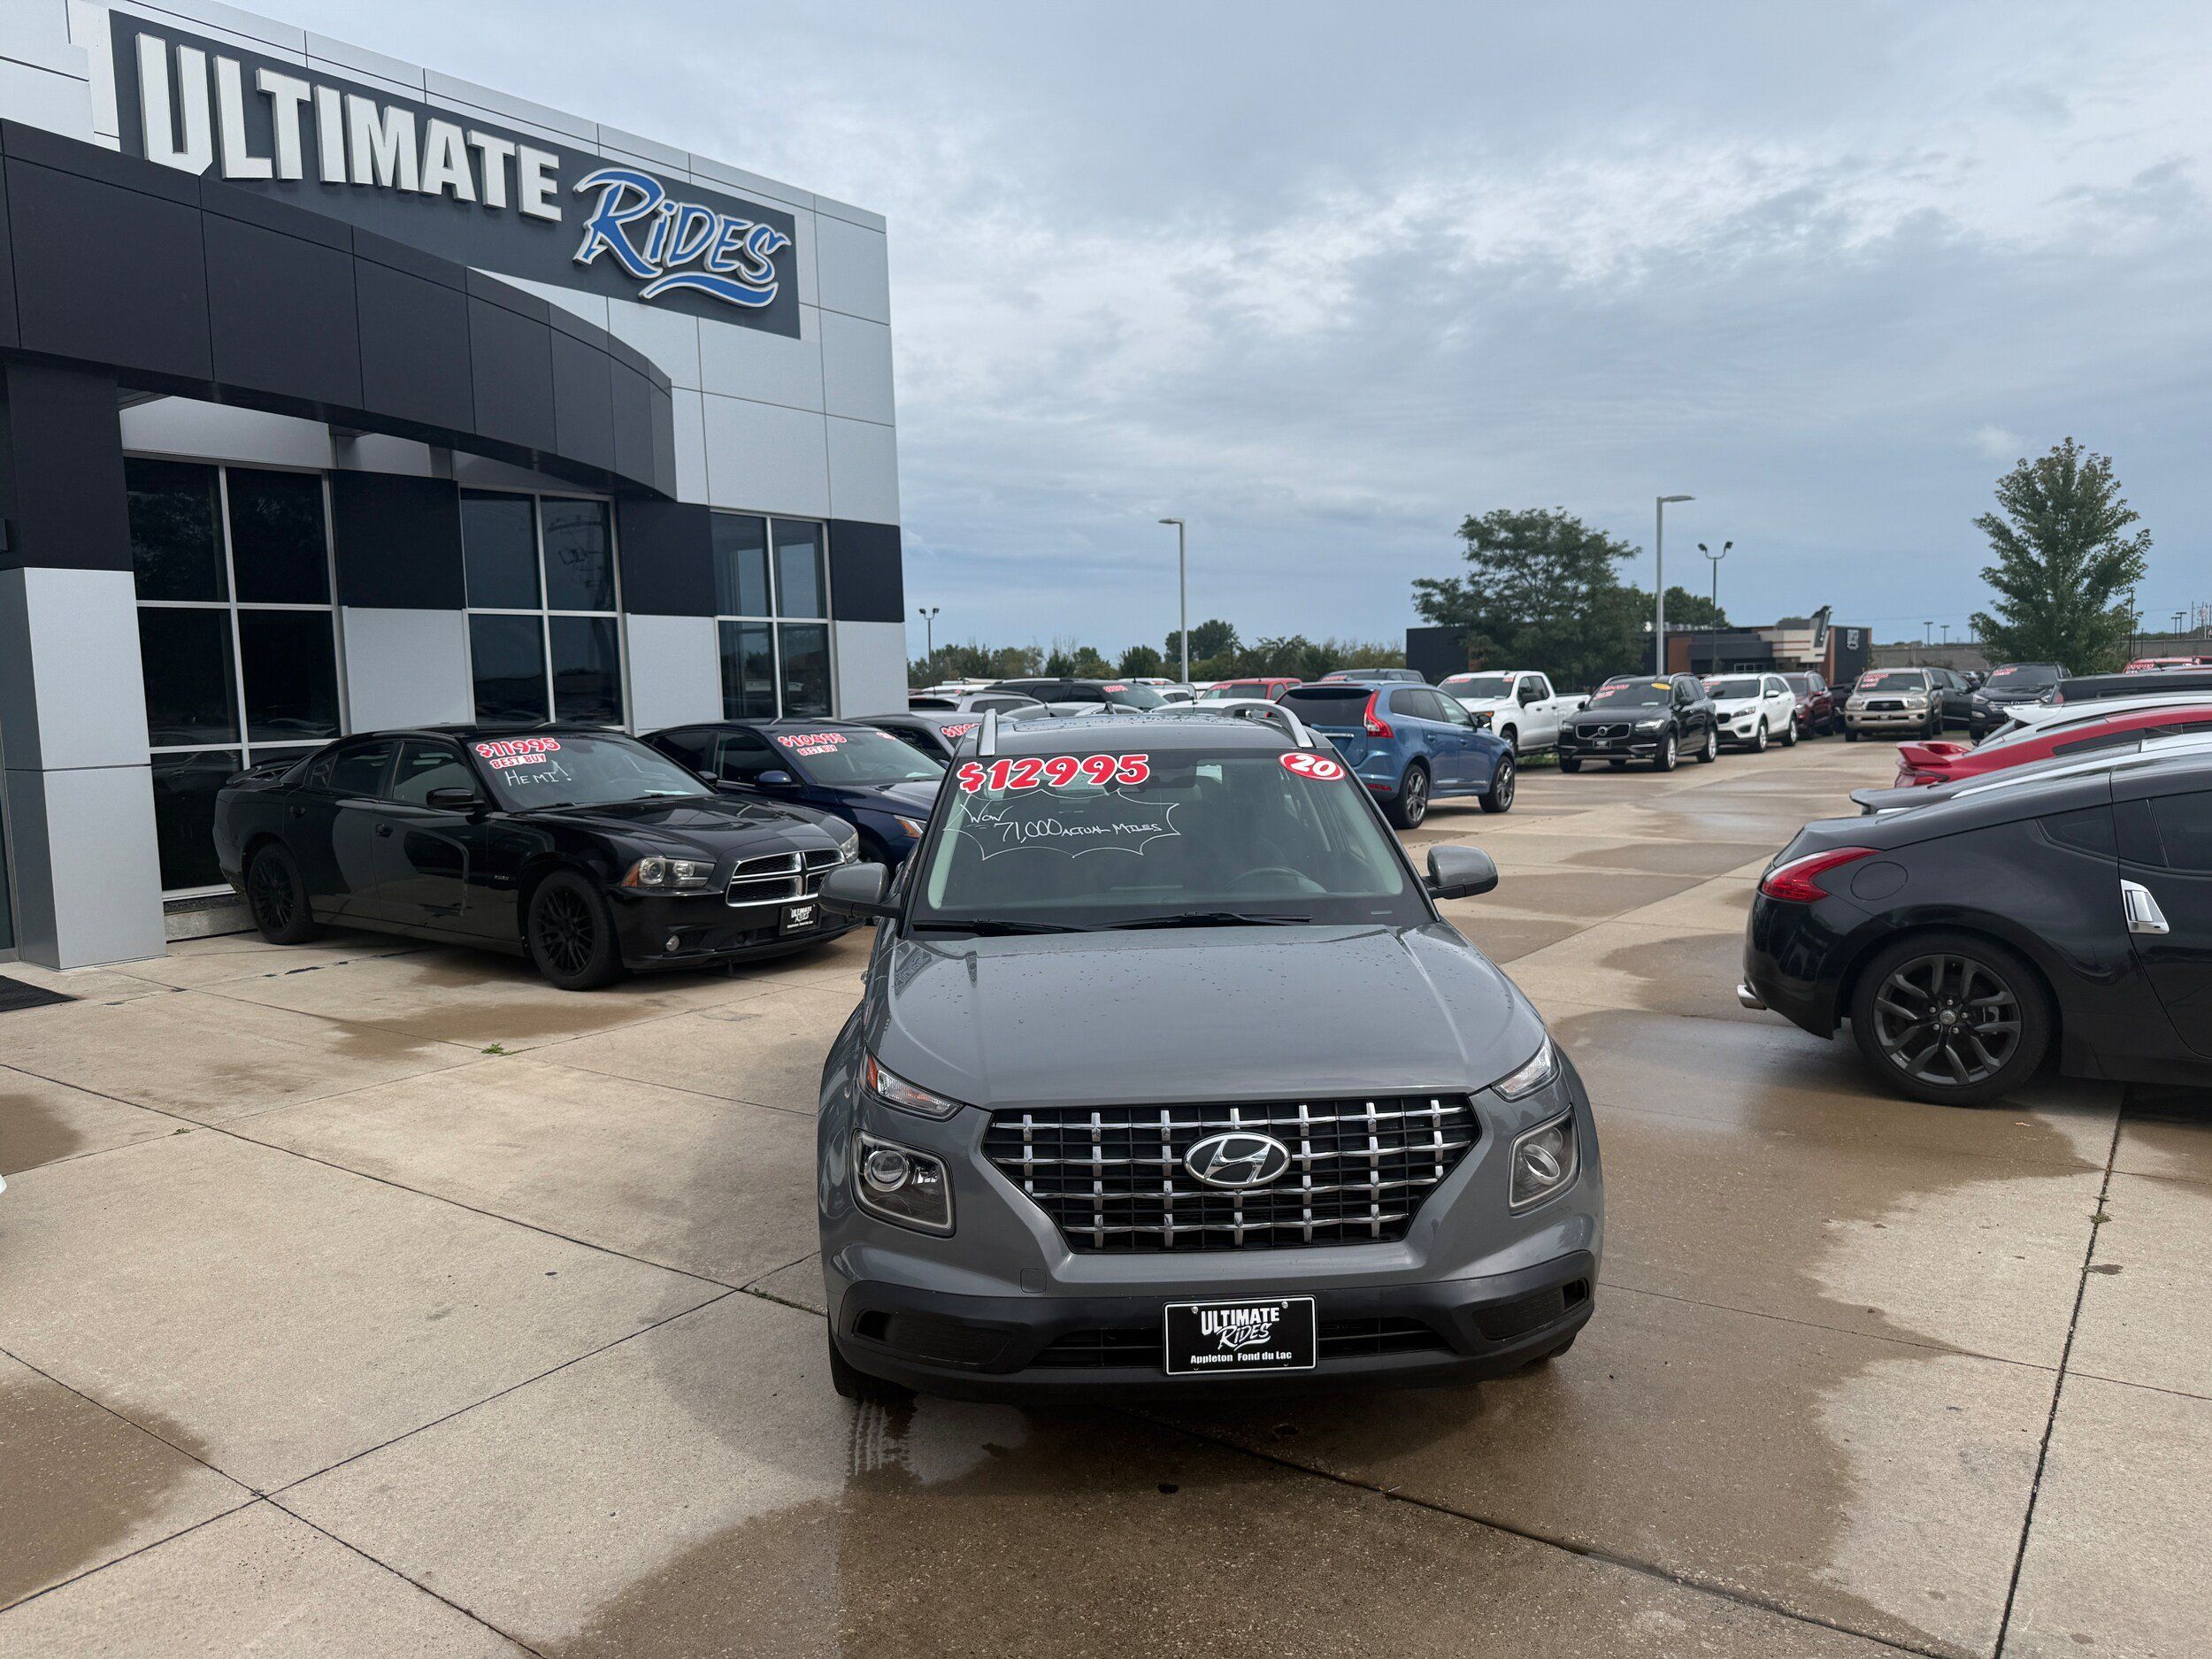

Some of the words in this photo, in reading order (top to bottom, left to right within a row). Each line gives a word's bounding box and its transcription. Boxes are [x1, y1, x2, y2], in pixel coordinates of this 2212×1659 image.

[135, 32, 563, 221] ULTIMATE
[476, 737, 561, 758] $11995
[490, 756, 521, 769] BEST
[523, 753, 547, 764] BUY
[1291, 754, 1337, 777] 20
[956, 754, 1150, 794] $12995
[994, 818, 1063, 843] 71,000
[1062, 826, 1110, 837] ACTUAL
[1201, 1307, 1280, 1336] ULTIMATE
[1190, 1354, 1233, 1364] Appleton
[1237, 1353, 1260, 1362] Fond
[1262, 1351, 1274, 1361] du
[1276, 1350, 1293, 1360] Lac
